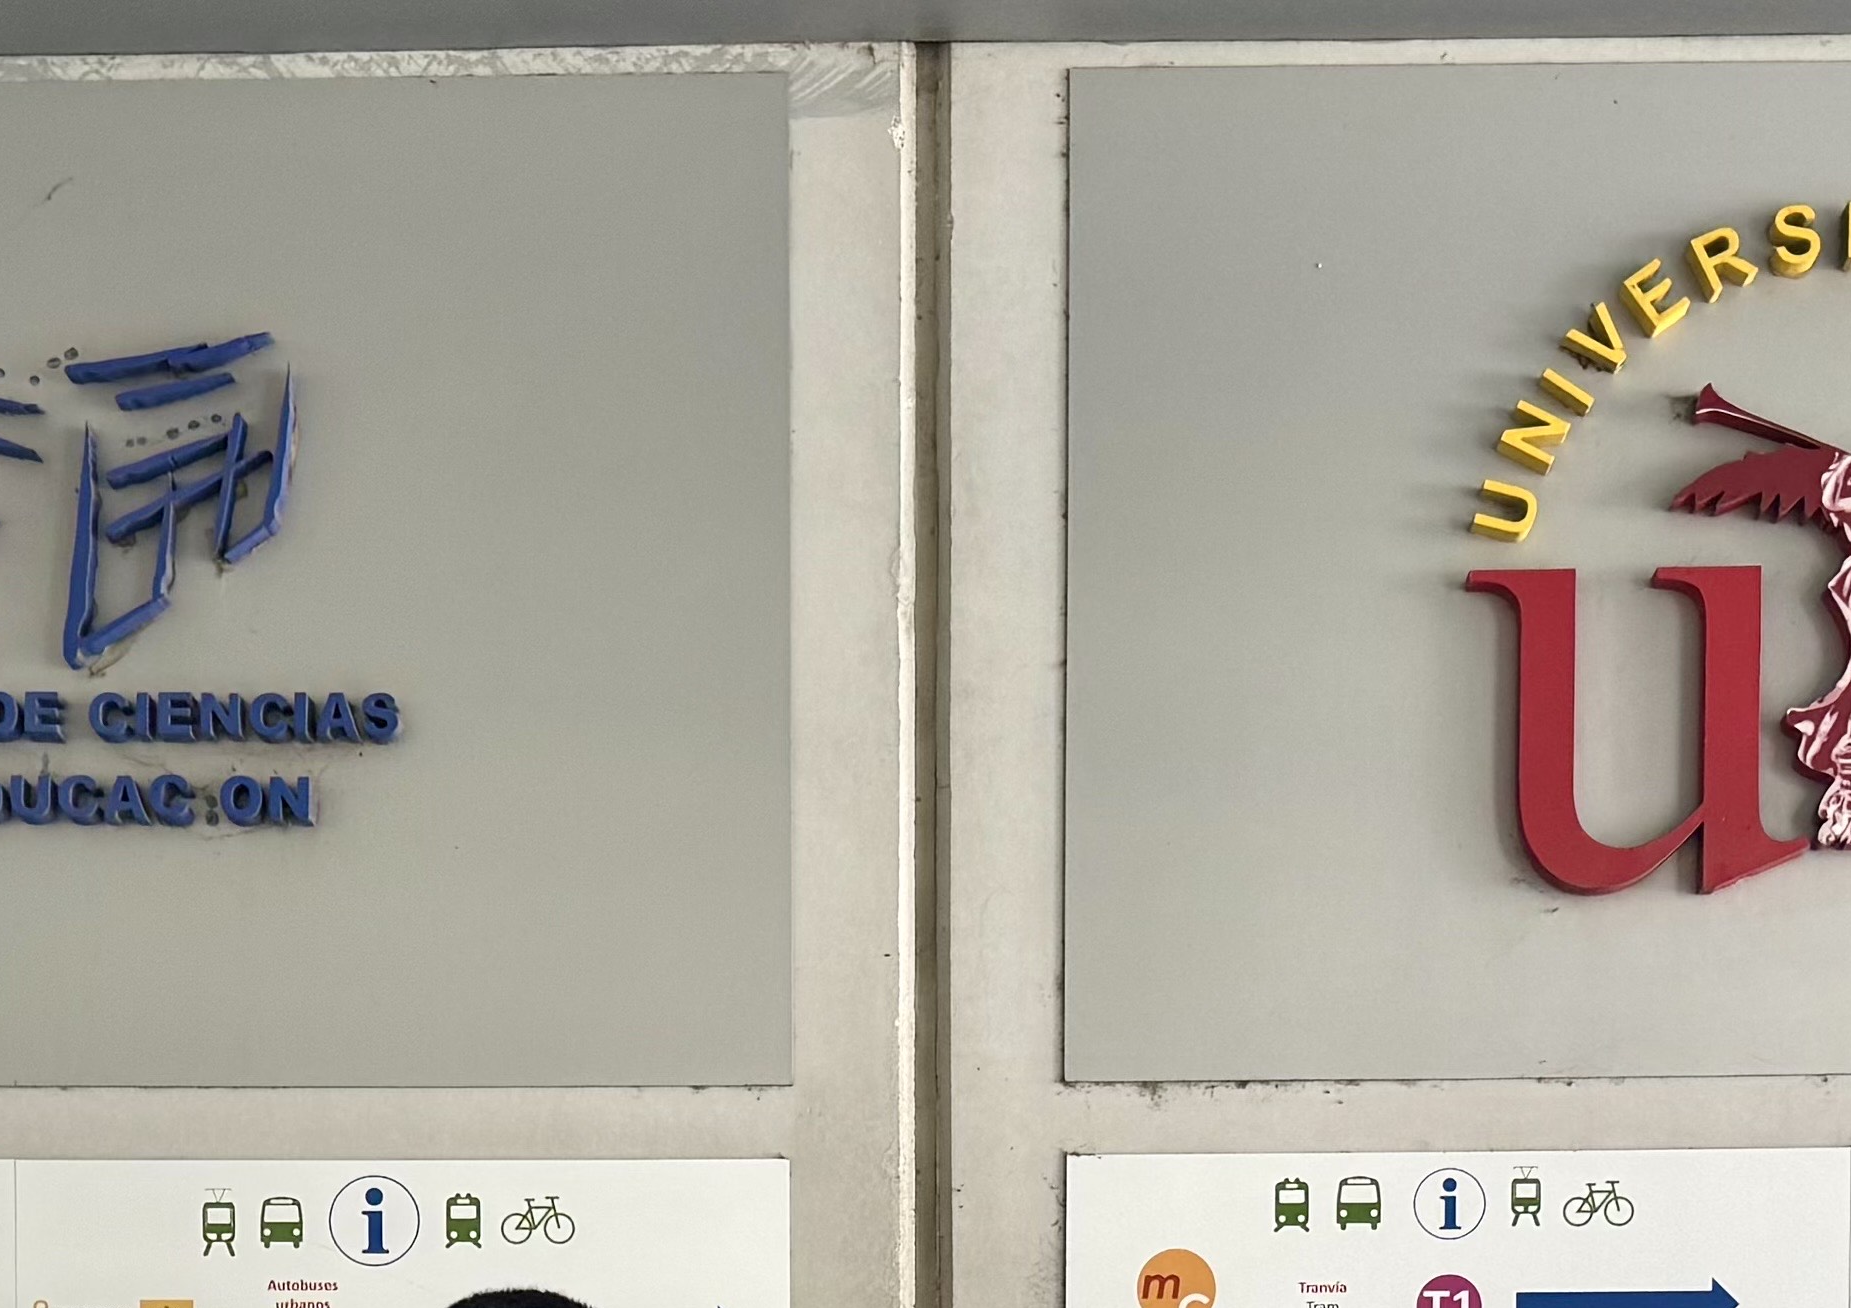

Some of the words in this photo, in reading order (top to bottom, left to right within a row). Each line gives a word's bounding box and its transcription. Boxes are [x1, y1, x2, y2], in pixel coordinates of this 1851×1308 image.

[89, 691, 403, 745] CIENCIAS
[267, 1279, 339, 1292] Autobuses
[1298, 1281, 1347, 1294] Tranvía
